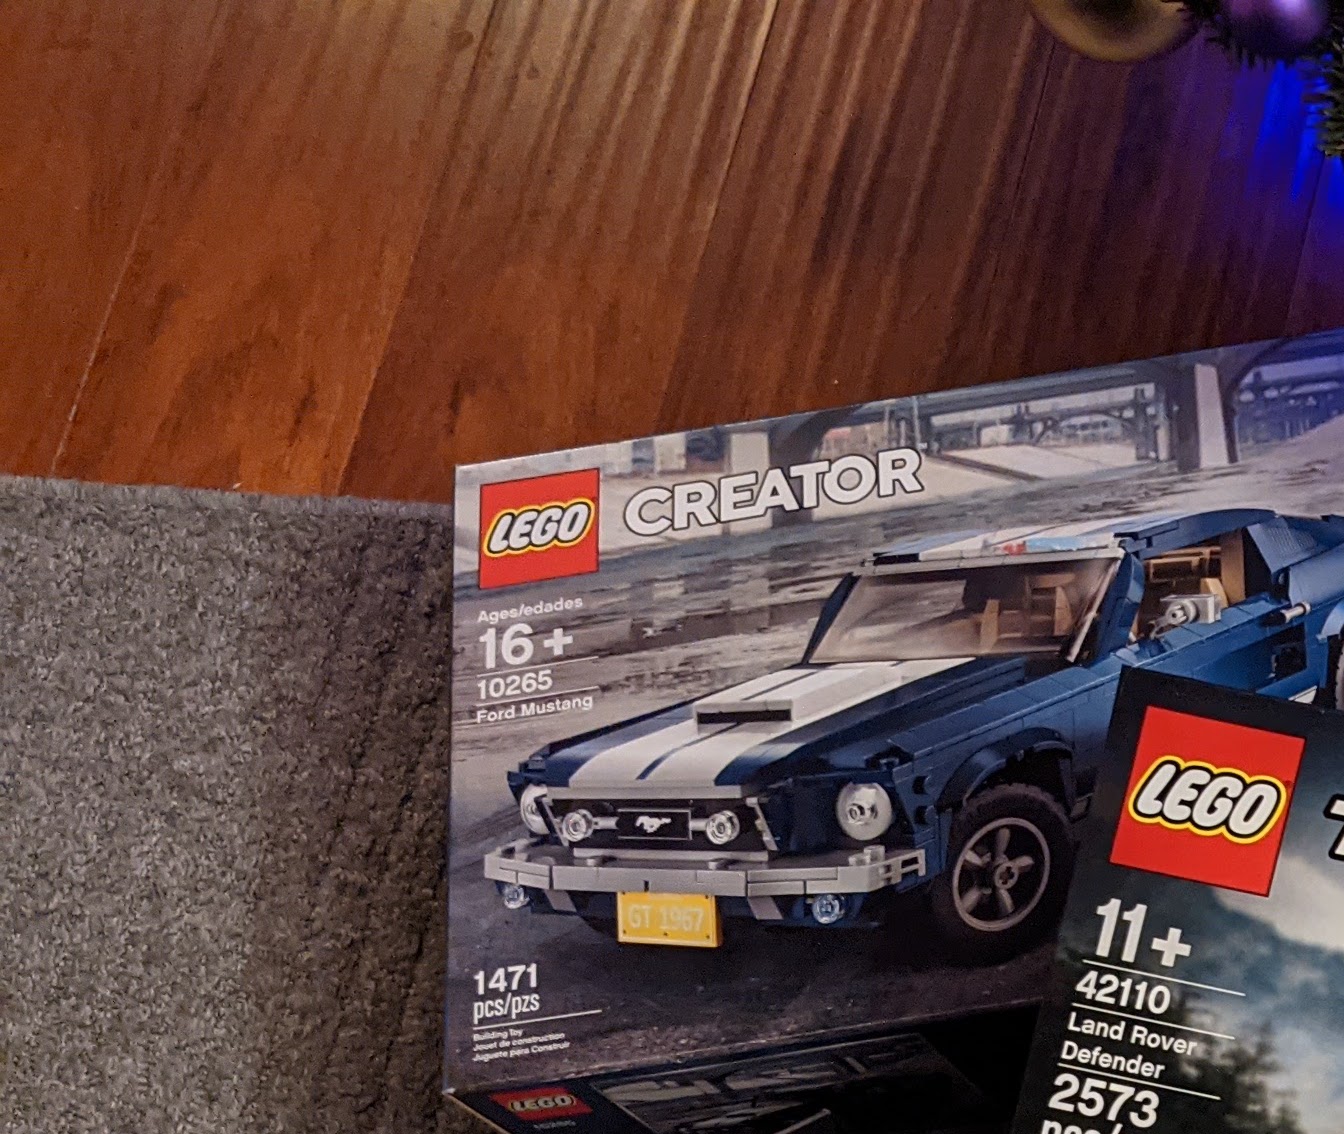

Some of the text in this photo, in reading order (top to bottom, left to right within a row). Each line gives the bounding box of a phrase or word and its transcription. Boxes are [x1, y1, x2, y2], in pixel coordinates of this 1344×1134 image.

[624, 449, 923, 536] CREATOR
[486, 500, 593, 556] LEGO
[478, 597, 583, 624] Ages/edades
[479, 623, 573, 669] 16+
[477, 669, 553, 700] 10265
[476, 696, 593, 723] Ford Mustang
[1132, 759, 1283, 838] LEGO
[628, 904, 652, 929] GT
[1096, 897, 1192, 967] 11+
[473, 963, 537, 995] 1471
[1075, 970, 1171, 1015] 42110
[473, 992, 540, 1025] pcs/pzs
[1067, 1011, 1198, 1056] Land Rover
[1060, 1040, 1165, 1079] Defender
[510, 1094, 575, 1113] LEGO
[1048, 1072, 1160, 1128] 2573
